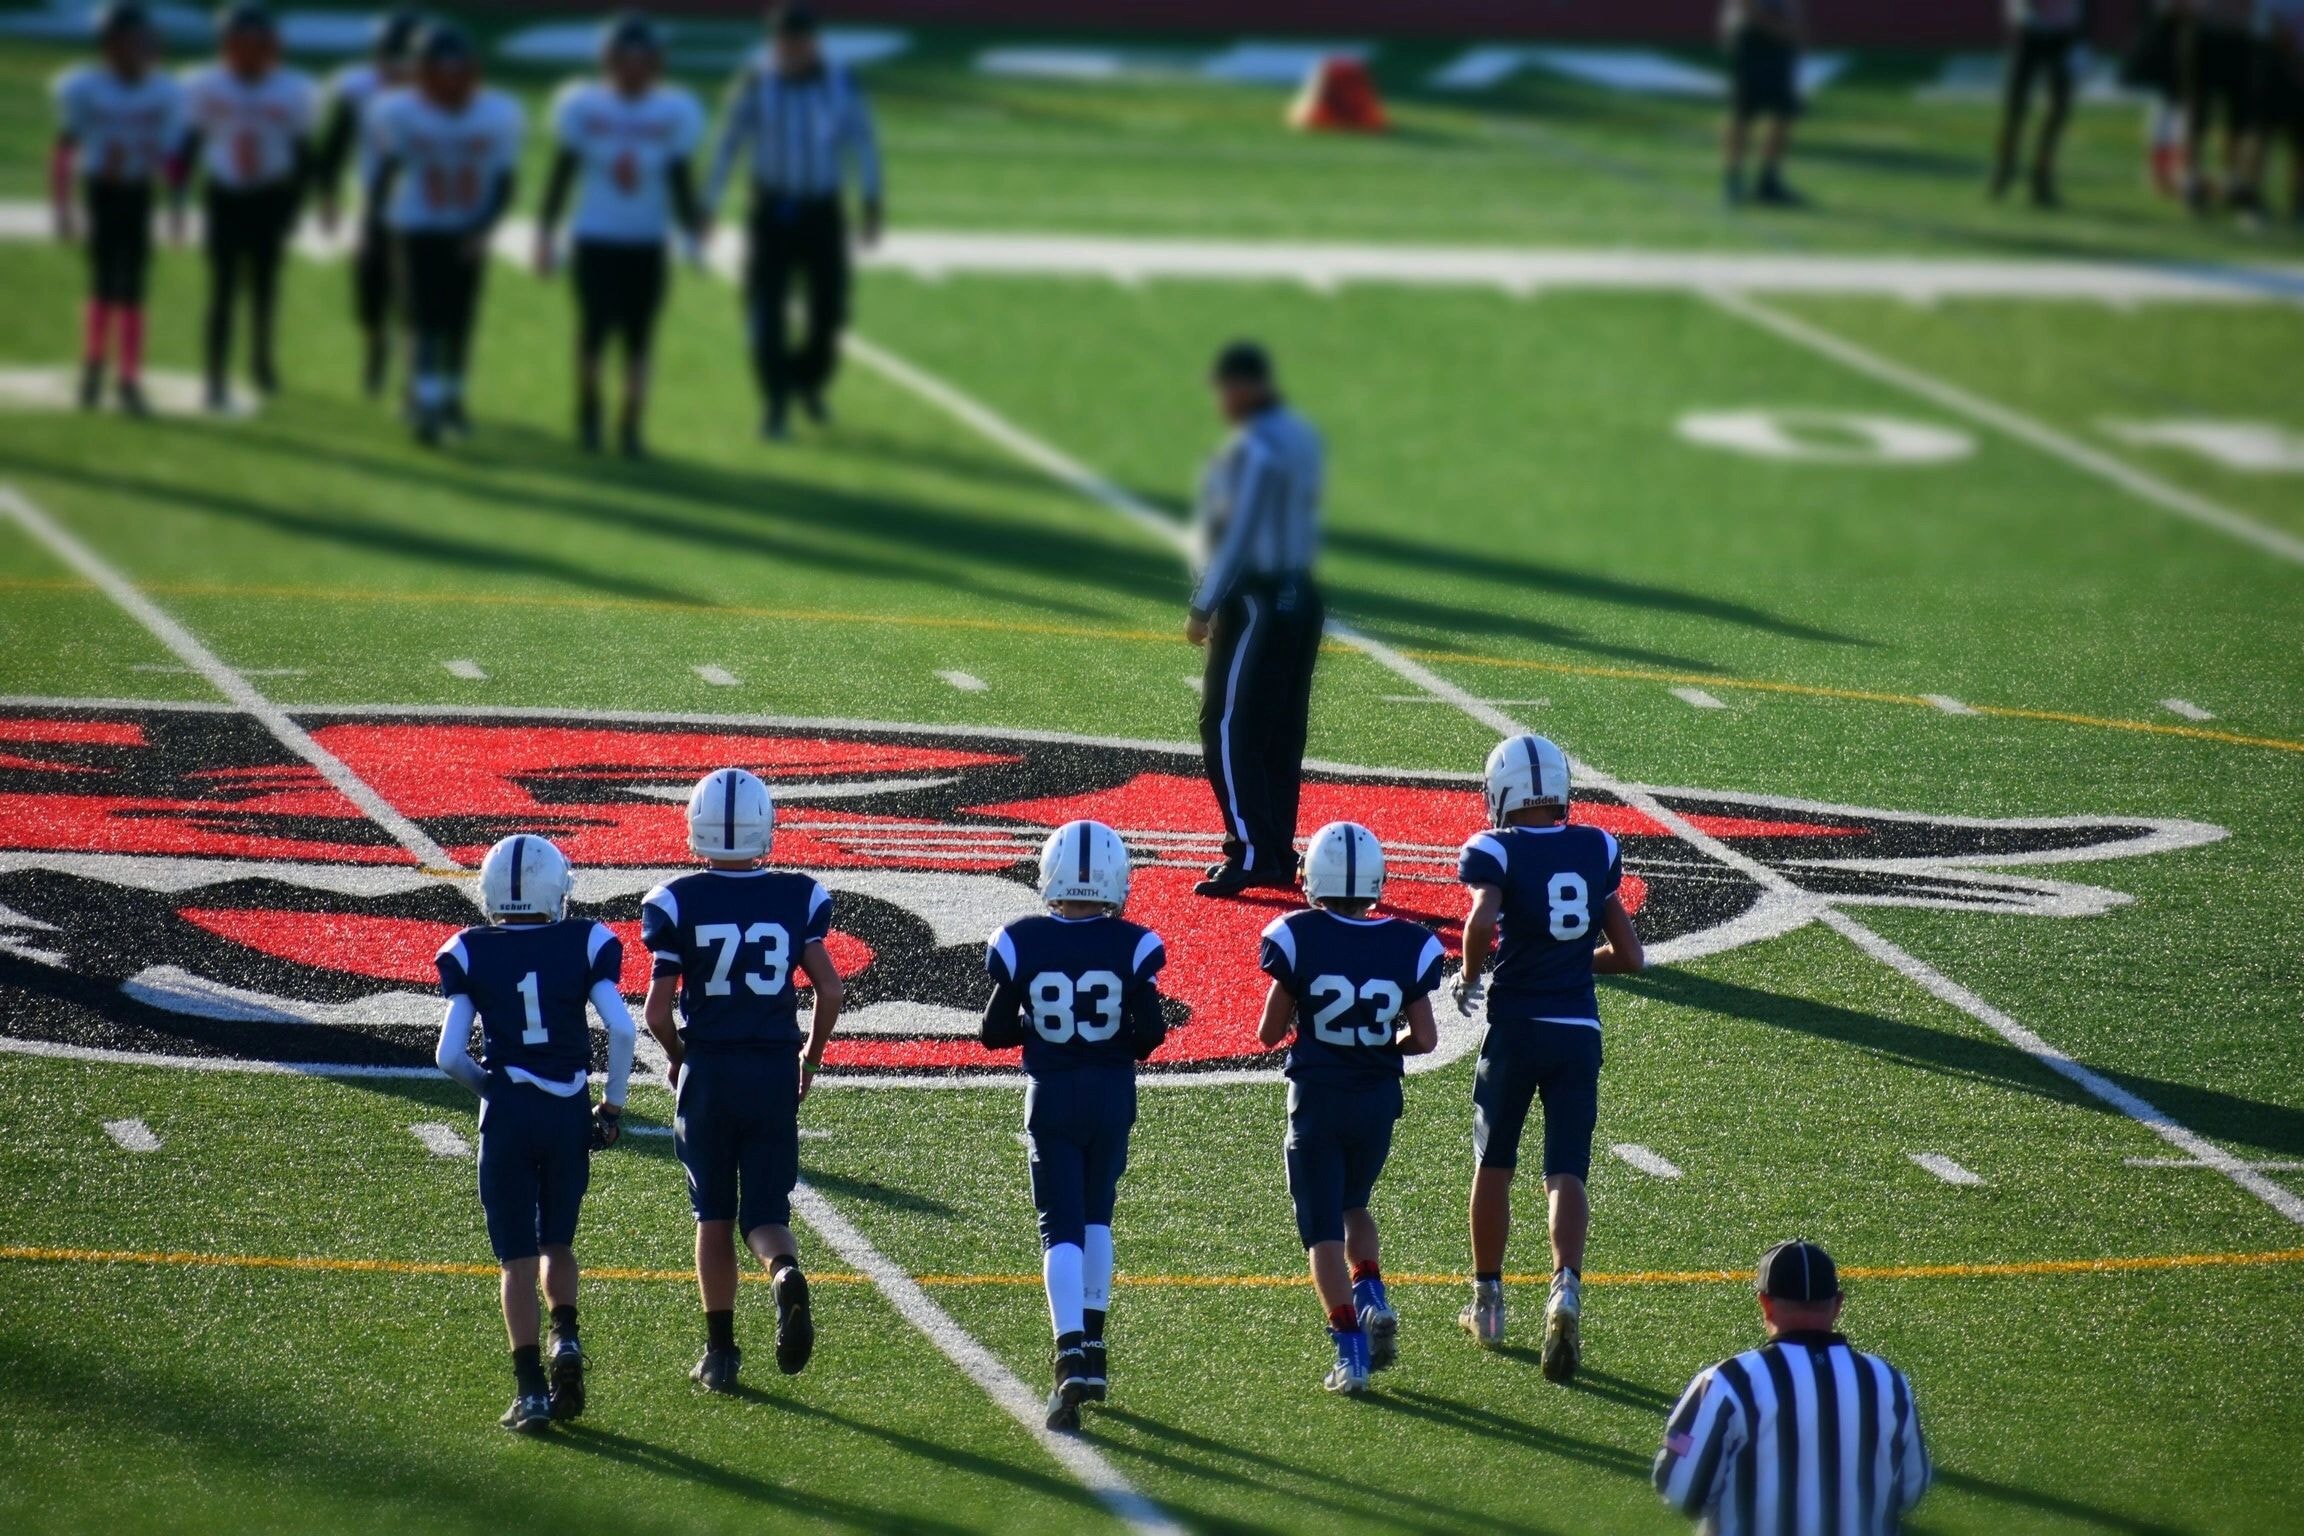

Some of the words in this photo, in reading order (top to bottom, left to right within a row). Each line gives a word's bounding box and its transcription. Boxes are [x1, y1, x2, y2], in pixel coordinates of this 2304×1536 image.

[1523, 795, 1560, 807] Riddell
[1065, 887, 1099, 897] XENITH
[1546, 871, 1591, 942] 8
[695, 922, 790, 997] 73
[516, 970, 549, 1046] 1
[1029, 970, 1123, 1044] 83
[1310, 974, 1402, 1046] 23
